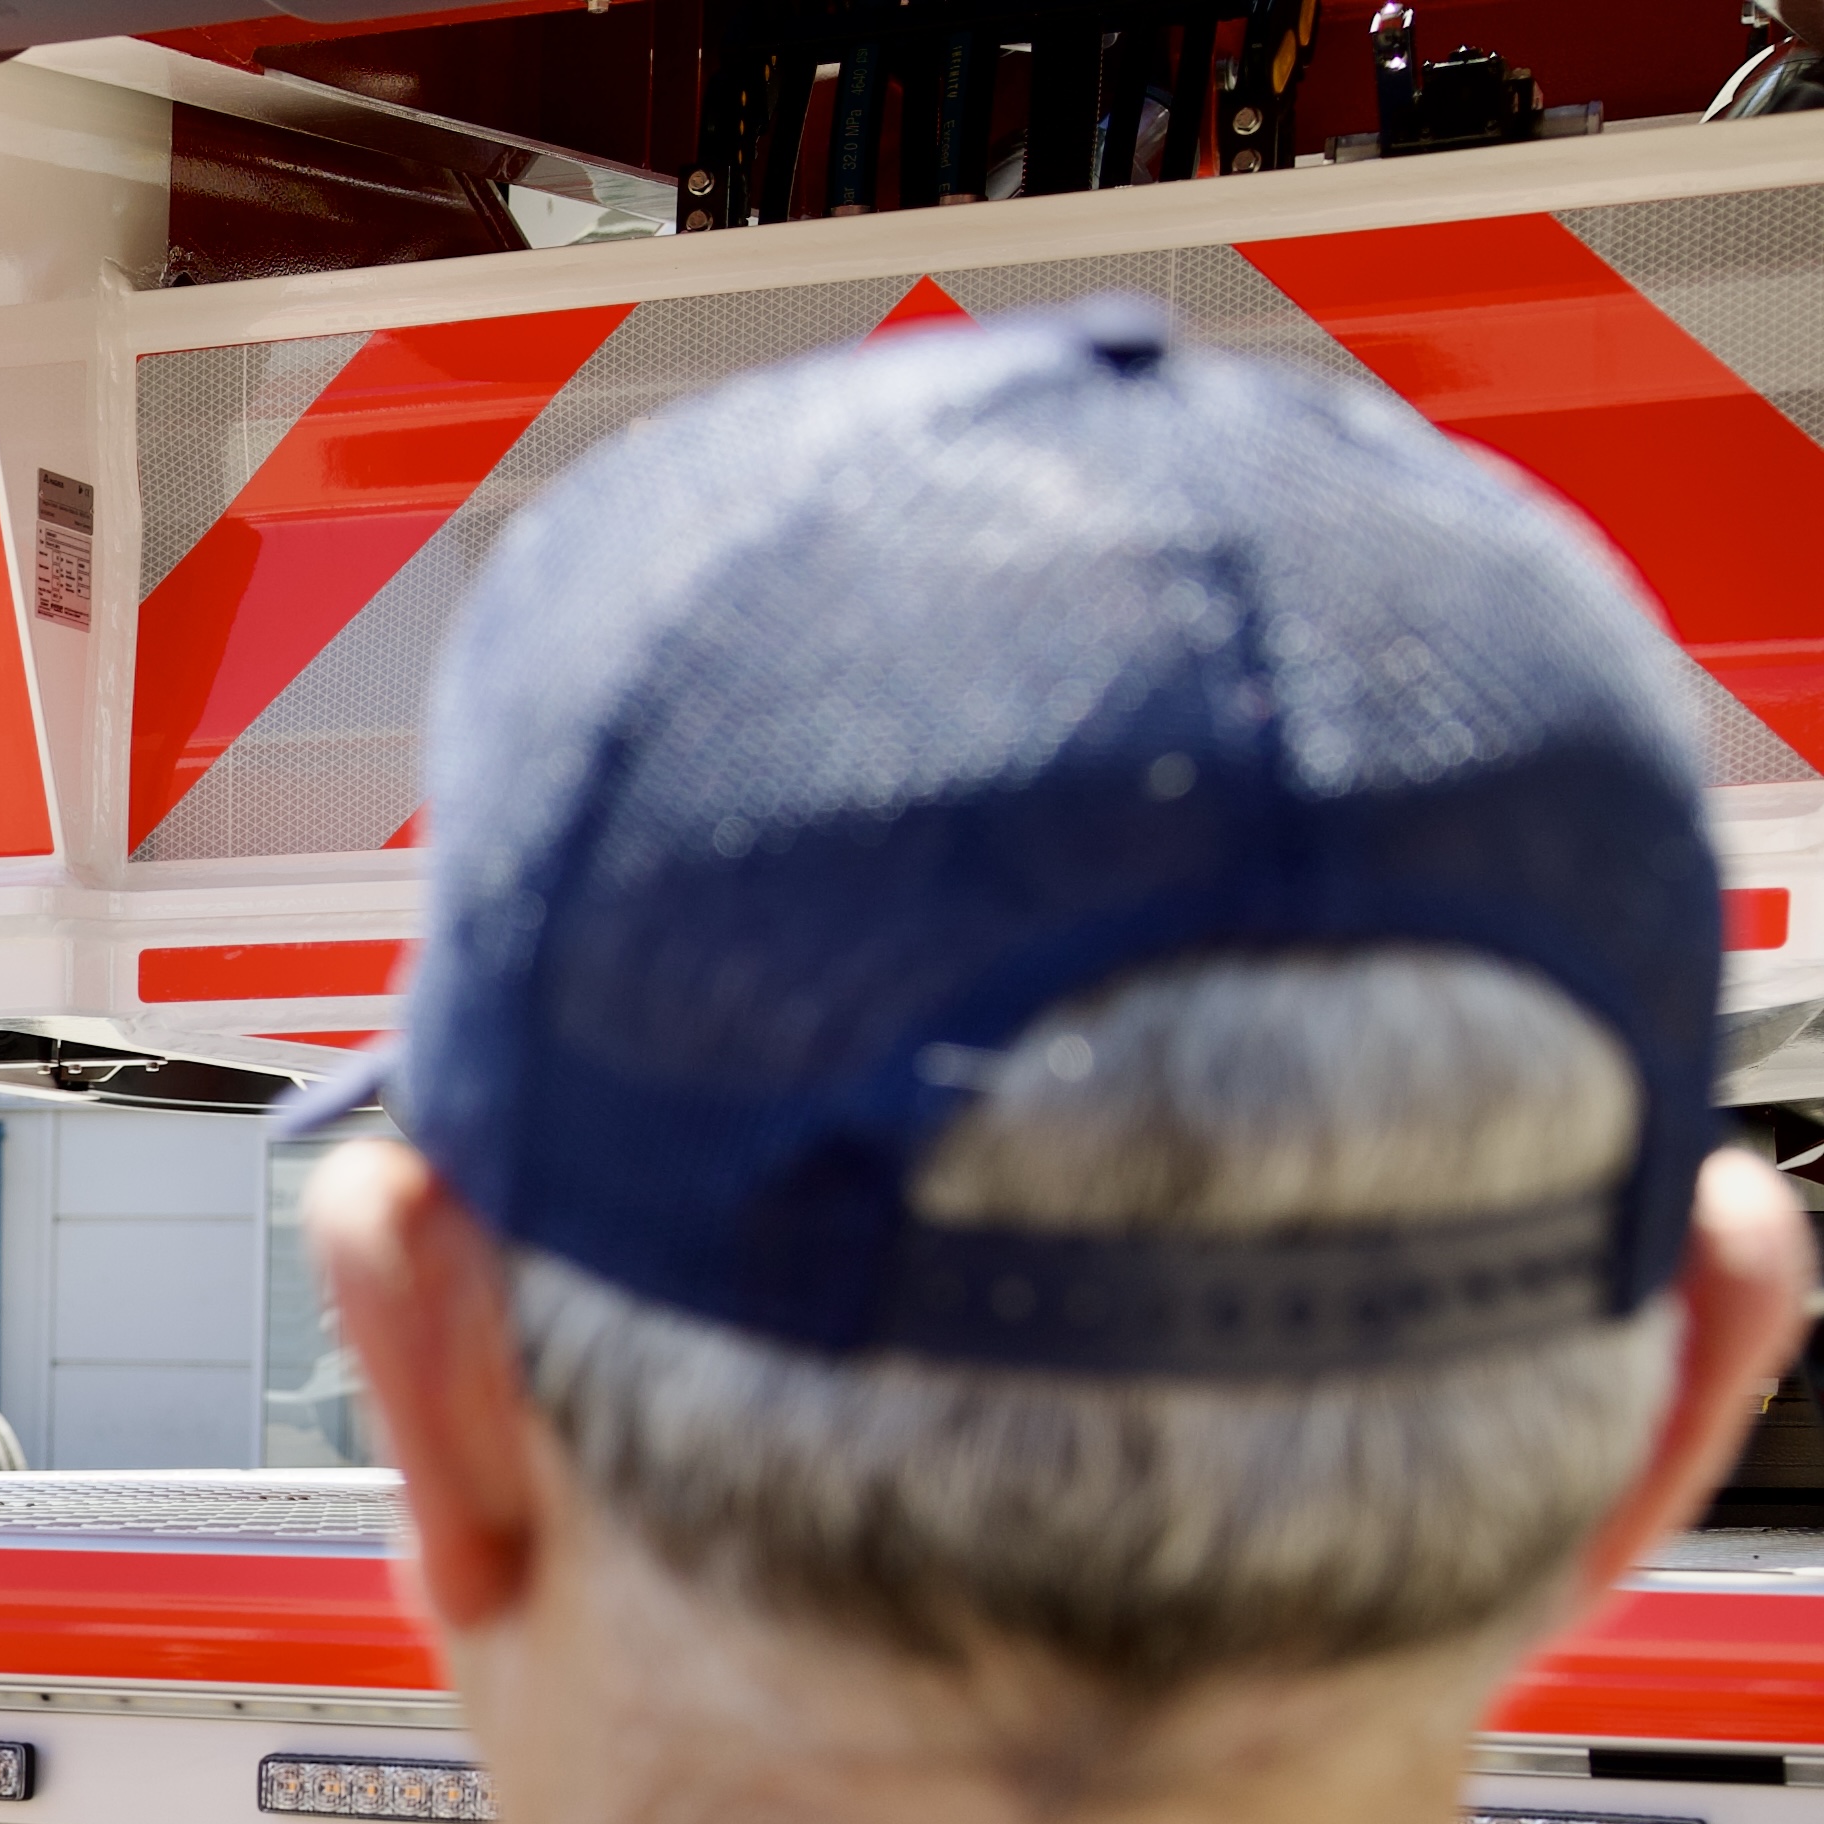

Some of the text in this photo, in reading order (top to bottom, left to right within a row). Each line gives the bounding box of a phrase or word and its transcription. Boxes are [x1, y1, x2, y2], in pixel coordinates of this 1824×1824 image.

[851, 68, 868, 96] 4640
[846, 109, 863, 137] MPa
[843, 142, 858, 170] 32.0
